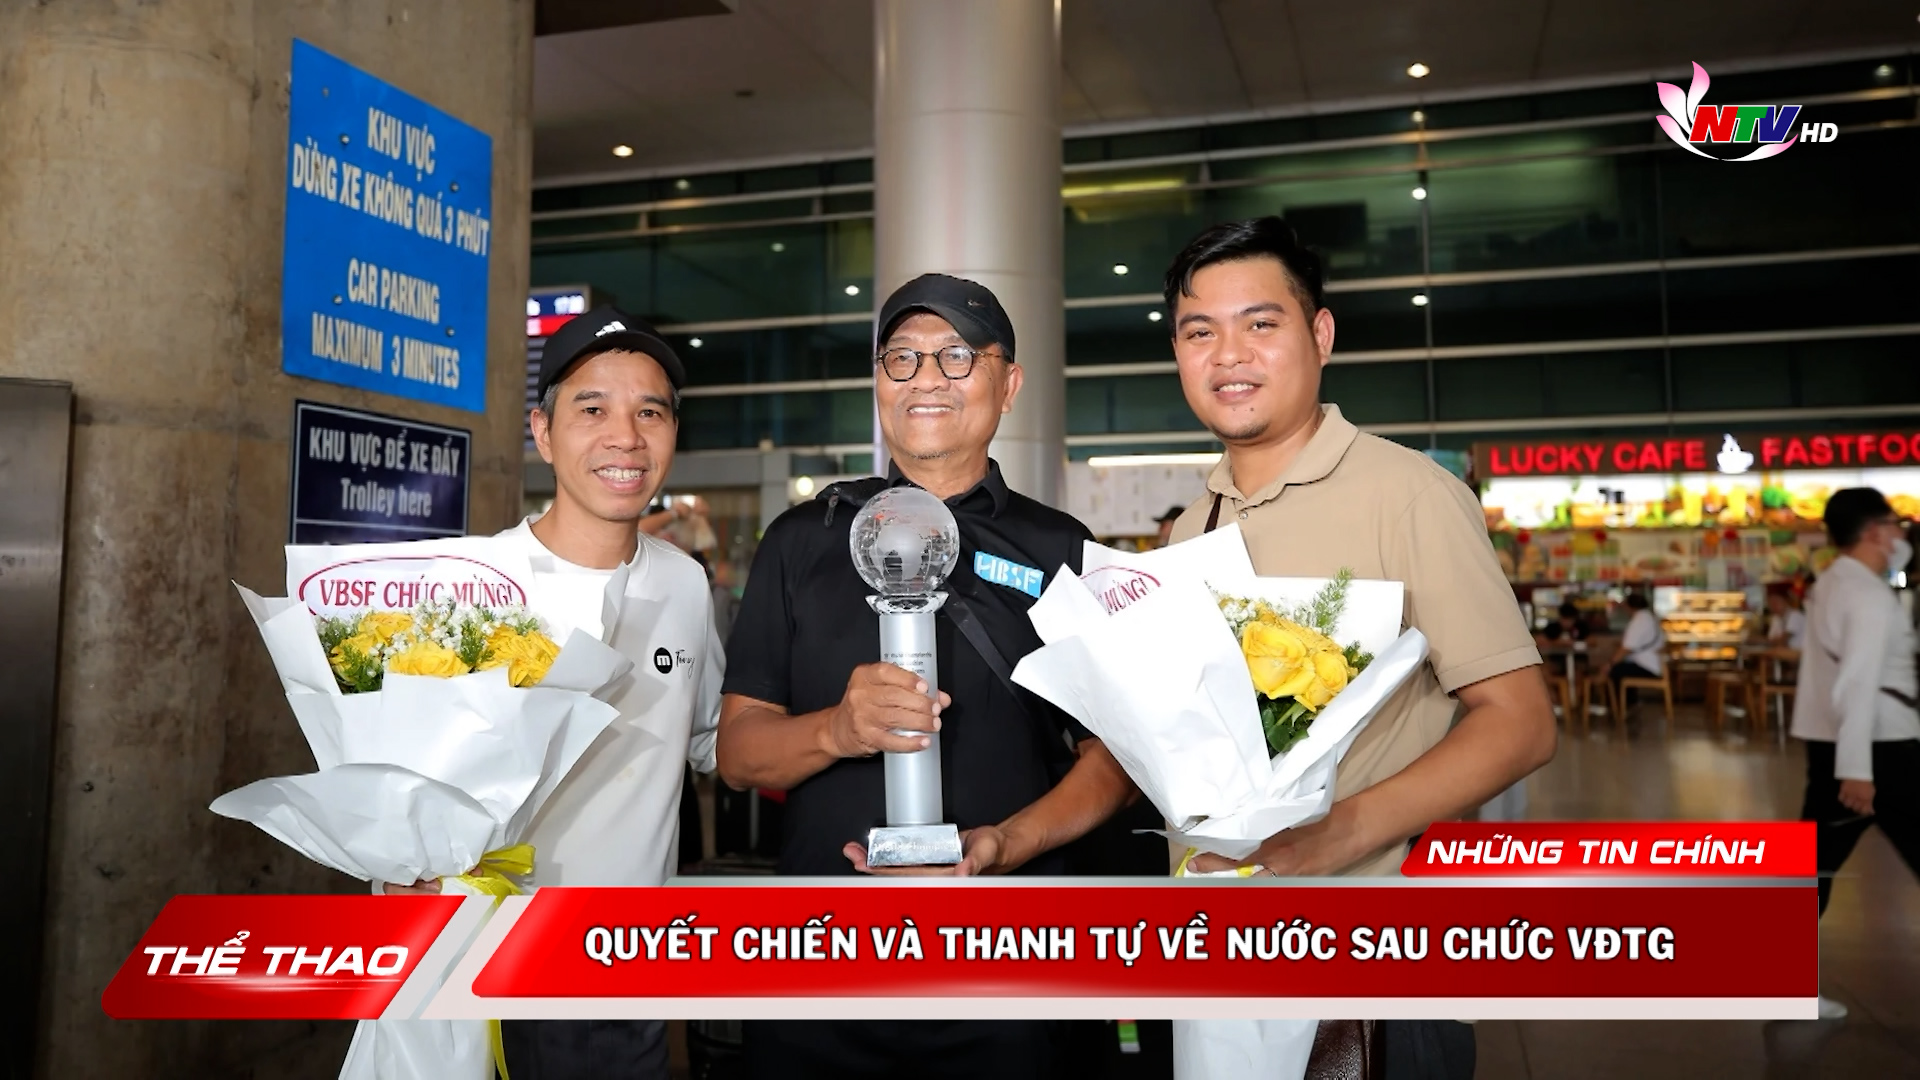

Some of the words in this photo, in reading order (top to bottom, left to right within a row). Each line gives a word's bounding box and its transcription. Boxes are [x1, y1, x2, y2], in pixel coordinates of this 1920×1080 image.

[367, 106, 402, 160] KHU
[405, 124, 436, 182] VỰC
[292, 136, 338, 202] DỪNG
[339, 161, 362, 210] XE
[363, 170, 413, 230] KHÔNG
[415, 192, 443, 242] QUÁ
[445, 205, 454, 245] 3
[456, 208, 490, 257] PHÚT
[347, 257, 378, 307] CAR
[379, 267, 440, 325] PARKING
[311, 311, 384, 374] MAXIMUM
[391, 334, 401, 377] 3
[403, 337, 461, 390] MINUTES
[309, 426, 346, 463] KHU
[350, 431, 382, 472] VỰC
[384, 427, 408, 471] ĐỂ
[409, 441, 429, 474] XE
[1490, 444, 1604, 475] LUCKY
[1612, 441, 1706, 471] CAFE
[341, 477, 396, 518] Trolley
[398, 483, 432, 518] here
[319, 579, 377, 607] VBSF
[383, 574, 445, 608] CHÚC
